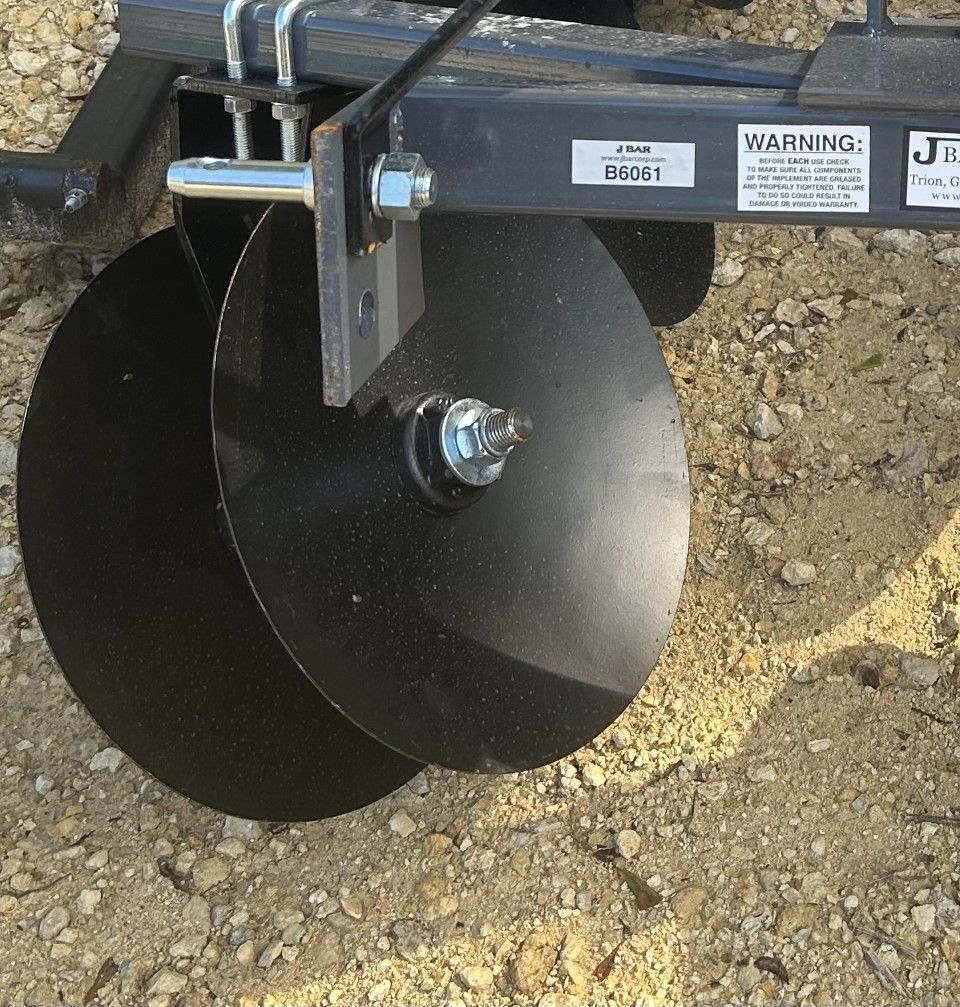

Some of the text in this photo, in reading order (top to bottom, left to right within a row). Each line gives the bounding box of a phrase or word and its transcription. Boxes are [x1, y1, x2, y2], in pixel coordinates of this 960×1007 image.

[616, 145, 651, 153] J BAR
[744, 133, 863, 152] WARNING:
[912, 137, 939, 165] J
[604, 165, 661, 181] B6061
[910, 174, 947, 188] Trion,
